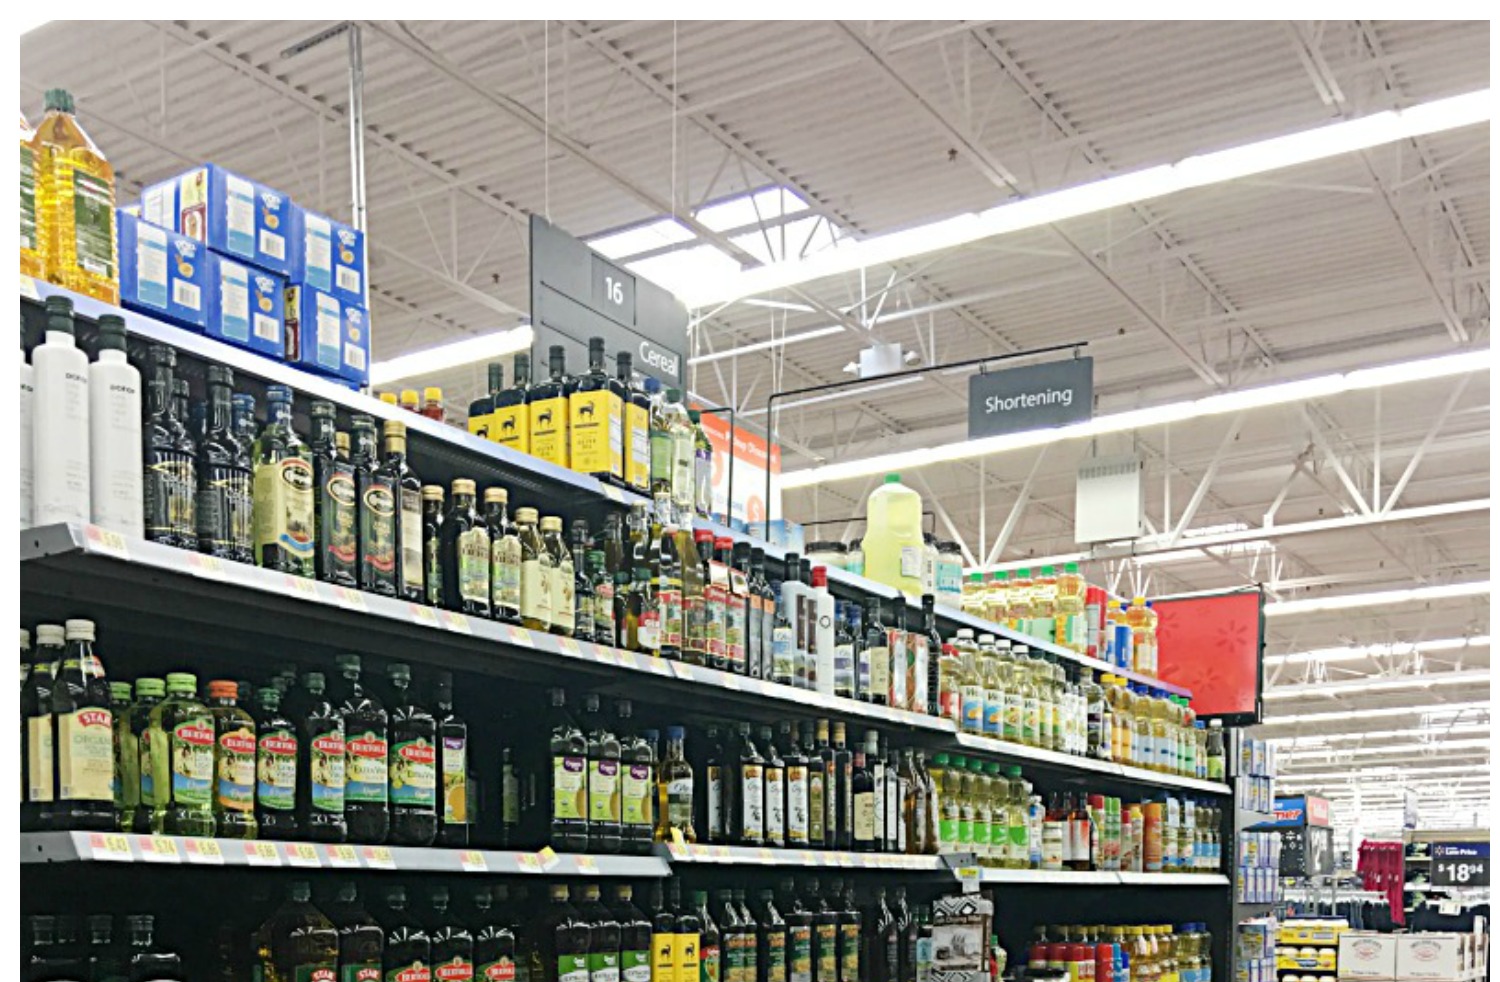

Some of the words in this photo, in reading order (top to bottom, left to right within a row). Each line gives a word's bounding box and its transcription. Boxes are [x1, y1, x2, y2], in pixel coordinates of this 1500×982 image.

[605, 277, 623, 305] 16
[639, 341, 679, 376] Cereal
[985, 388, 1073, 414] Shortening
